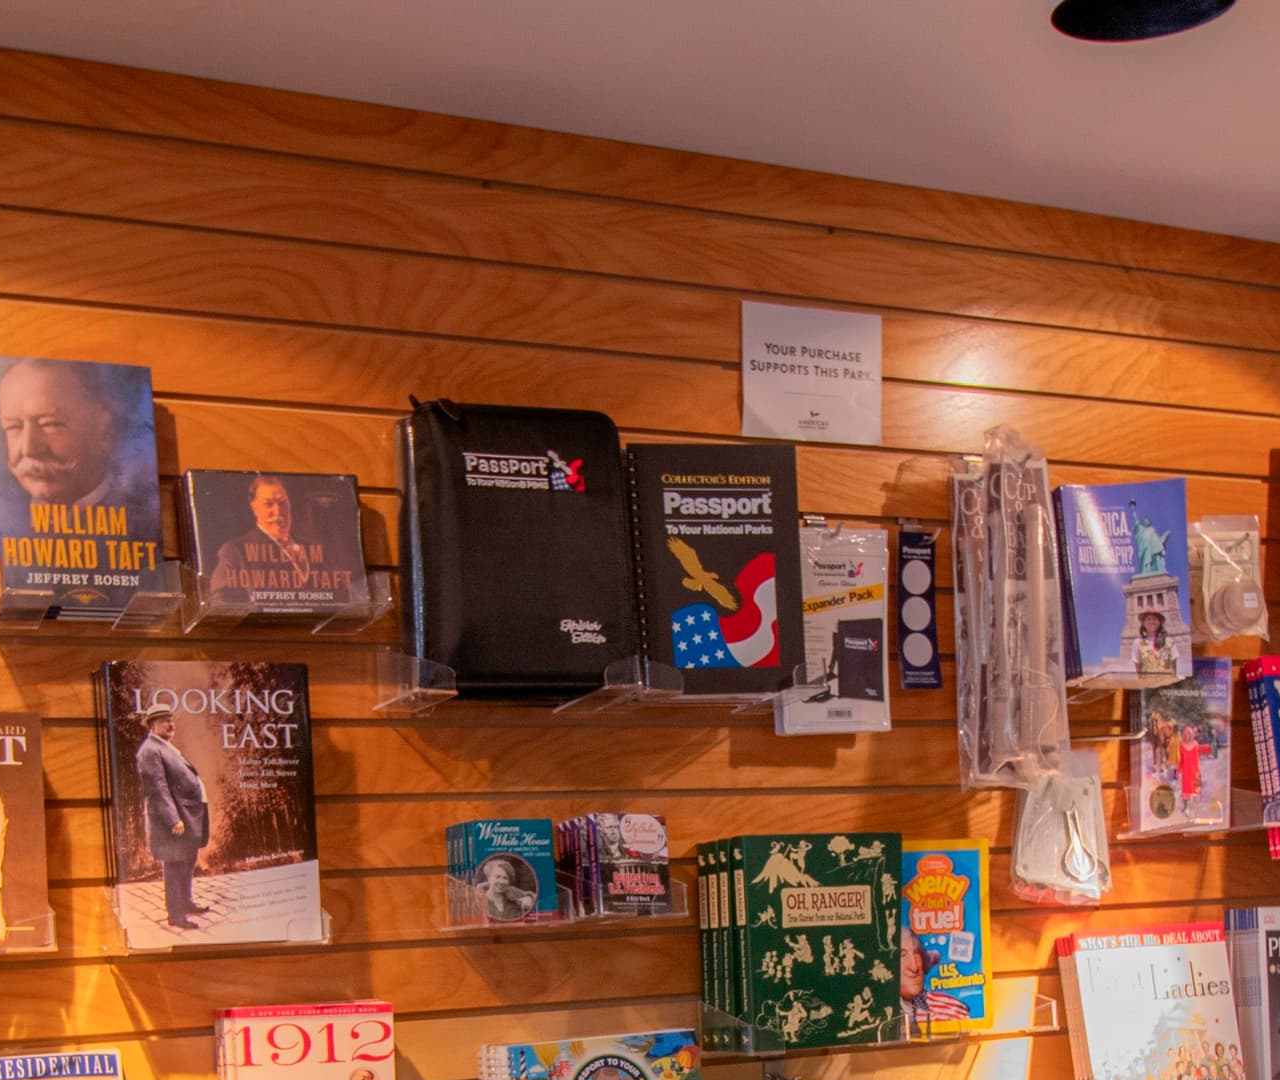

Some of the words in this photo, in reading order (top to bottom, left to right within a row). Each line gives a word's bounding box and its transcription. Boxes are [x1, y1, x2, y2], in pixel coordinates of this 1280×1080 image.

[764, 342, 796, 356] YOUR
[801, 346, 861, 362] PURCHASE
[750, 360, 809, 376] SUPPORTS
[814, 365, 839, 378] THIS
[662, 474, 726, 484] COLLECTOR'S
[728, 474, 771, 484] EDITION
[664, 492, 772, 518] Passport
[30, 503, 127, 535] WILLIAM
[666, 525, 678, 534] To
[679, 525, 702, 534] Your
[703, 525, 744, 534] National
[745, 525, 773, 534] Parks
[3, 538, 97, 570] HOWARD
[106, 540, 157, 570] TAFT
[244, 544, 324, 563] WILLIAM
[27, 573, 89, 585] JEFFREY
[94, 574, 139, 586] ROSEN
[226, 569, 305, 590] HOWARD
[310, 570, 353, 590] TAFT
[253, 592, 295, 600] JEFFREY
[298, 592, 333, 601] ROSEN
[802, 596, 845, 612] Expander
[849, 590, 873, 602] Pack
[135, 689, 294, 716] LOOKING
[222, 724, 298, 749] EAST
[476, 821, 520, 841] Women
[491, 834, 519, 846] White
[521, 834, 550, 845] House
[906, 876, 965, 900] weird
[786, 894, 809, 911] OH,
[811, 892, 865, 909] RANGER!
[913, 907, 960, 929] true!
[931, 973, 984, 991] Presidents
[239, 1019, 396, 1067] 1912
[620, 1061, 640, 1078] YOUR
